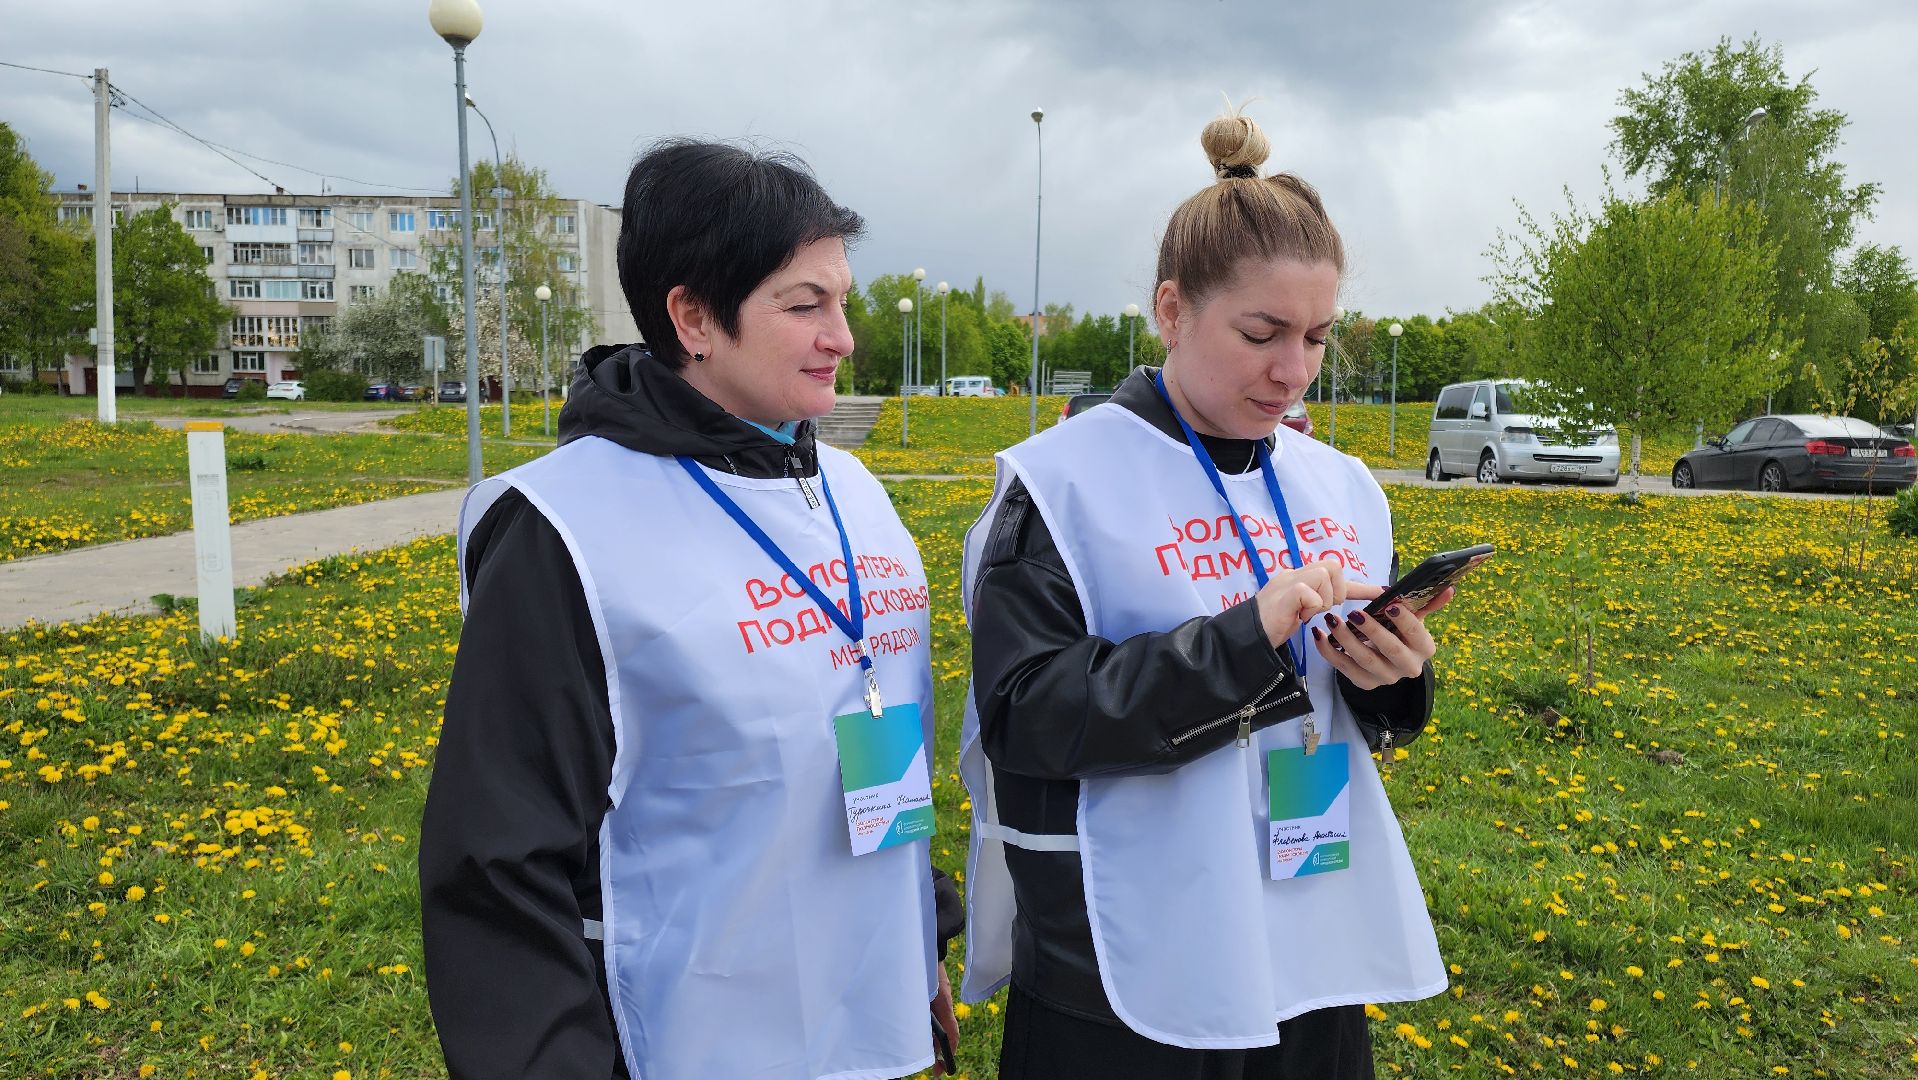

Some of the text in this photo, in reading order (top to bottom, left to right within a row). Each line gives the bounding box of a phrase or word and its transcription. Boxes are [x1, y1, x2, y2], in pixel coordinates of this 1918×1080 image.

[1168, 514, 1360, 545] ОЛОНЕРЫ
[745, 555, 909, 610] ВОЛОНТЕРЫ
[1221, 592, 1247, 610] М
[869, 627, 921, 657] РЯДОМ
